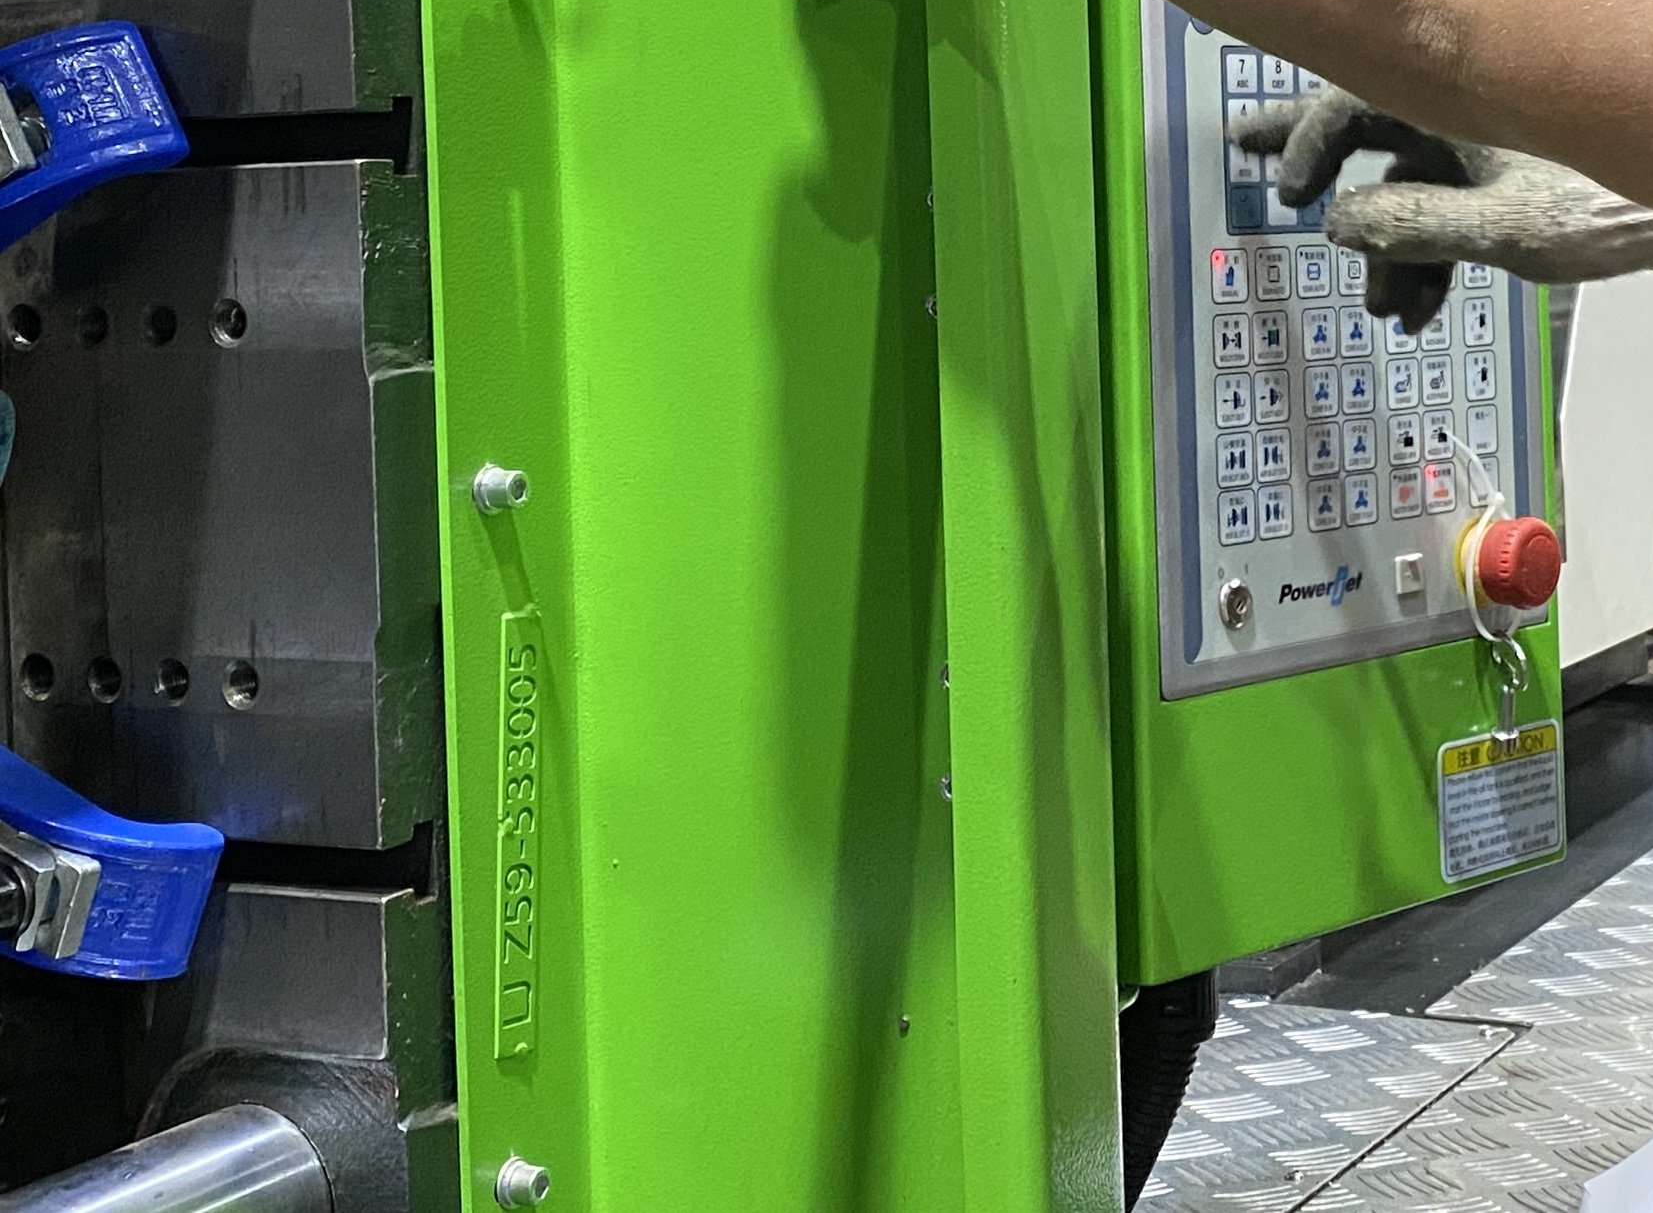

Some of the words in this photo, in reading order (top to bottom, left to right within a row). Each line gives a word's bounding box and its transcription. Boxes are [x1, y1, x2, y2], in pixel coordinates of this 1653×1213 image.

[1239, 59, 1245, 74] 7
[1275, 59, 1282, 74] 8
[1236, 79, 1249, 88] ABC
[1271, 79, 1286, 89] DEF
